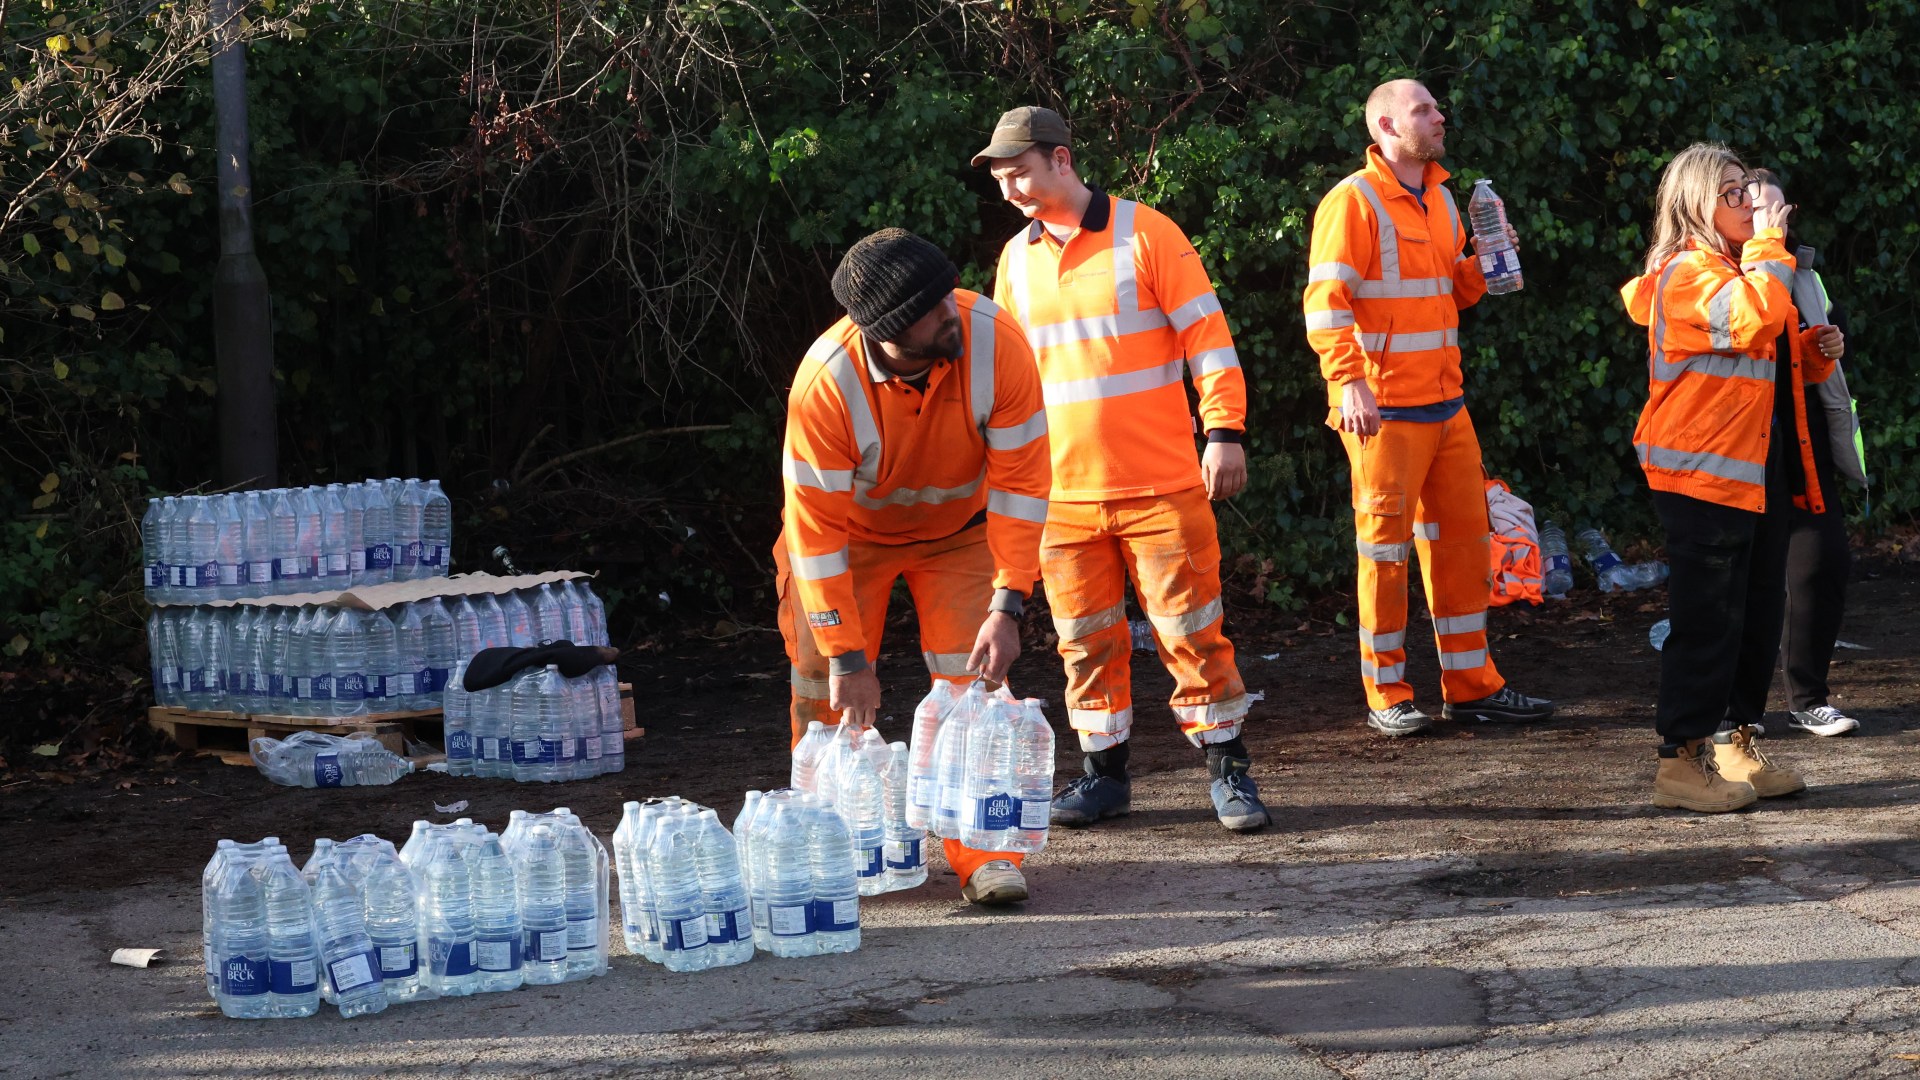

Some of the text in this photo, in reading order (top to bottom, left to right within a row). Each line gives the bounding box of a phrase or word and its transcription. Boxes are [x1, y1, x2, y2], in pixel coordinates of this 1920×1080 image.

[344, 682, 364, 691] BECK
[451, 740, 472, 749] BECK
[991, 799, 1009, 808] GILL
[229, 962, 251, 971] GILL
[227, 970, 255, 982] BECK
